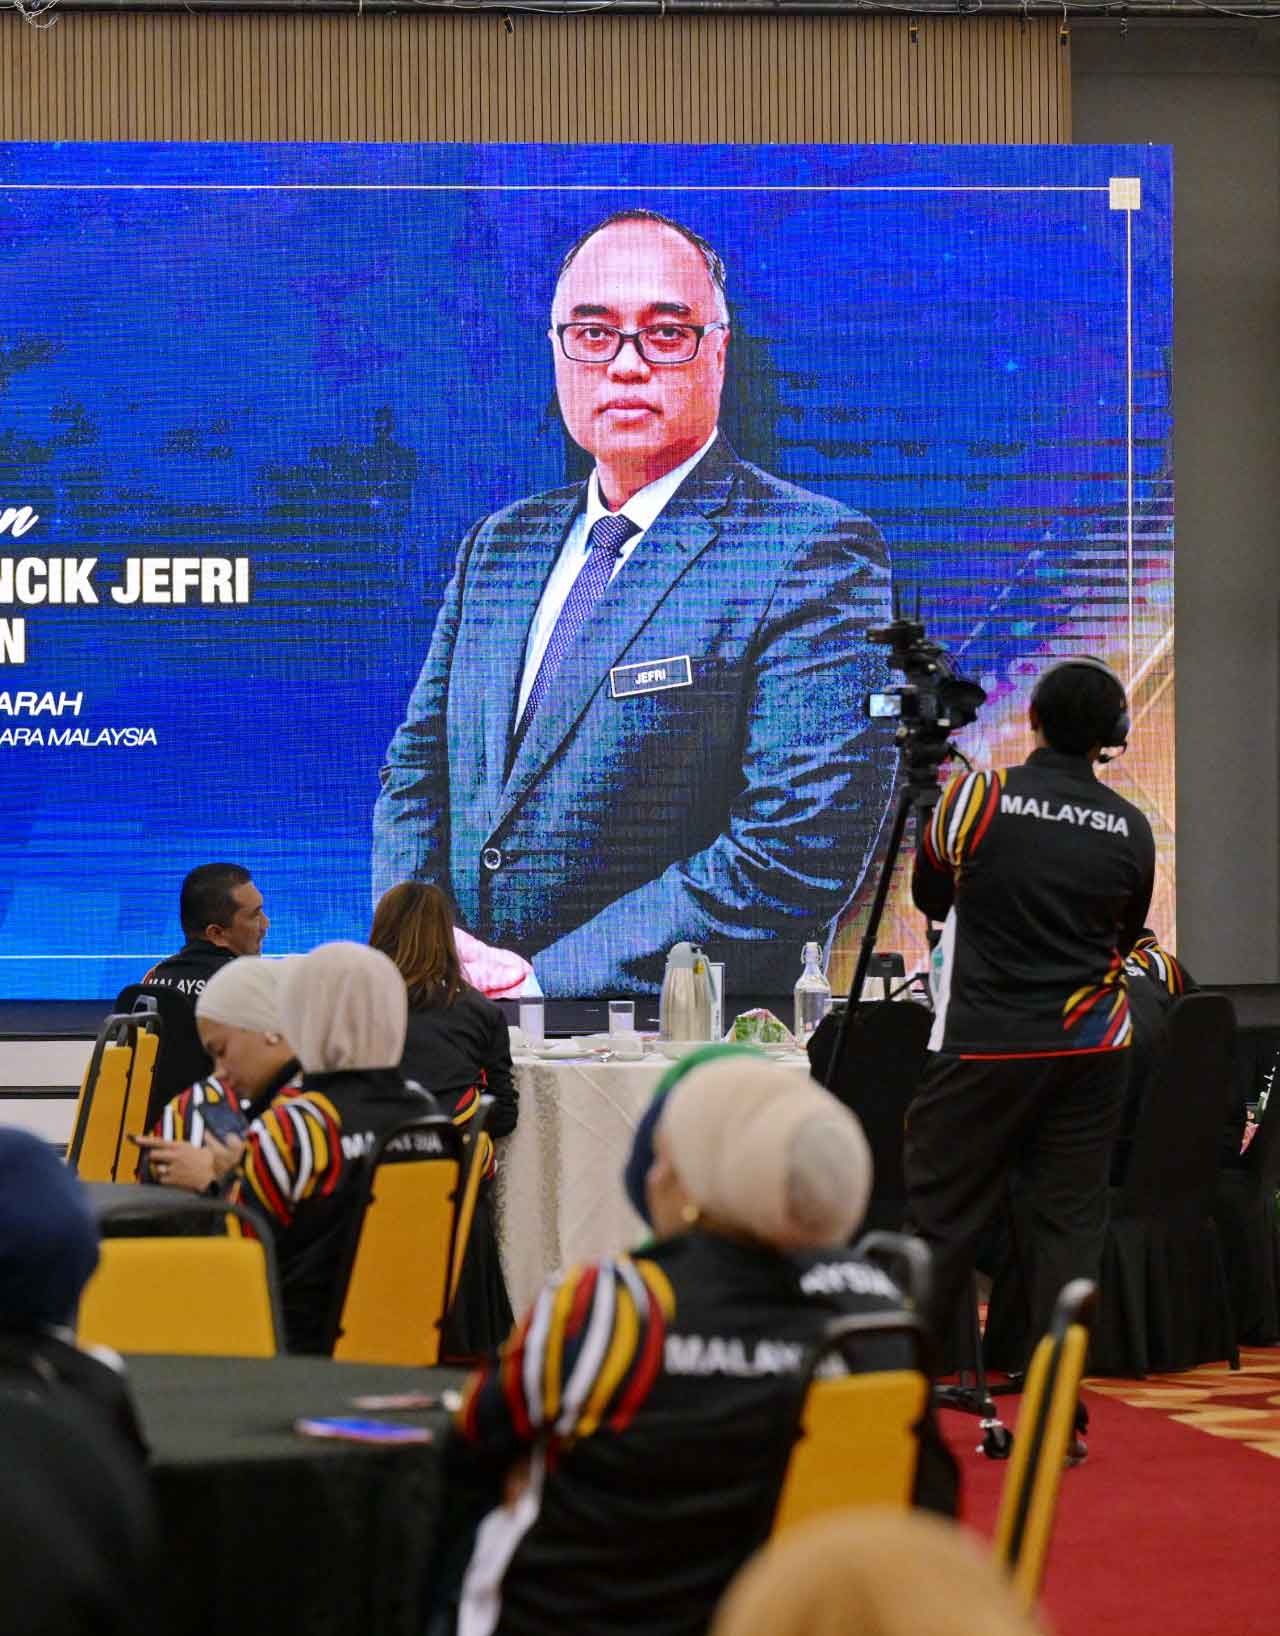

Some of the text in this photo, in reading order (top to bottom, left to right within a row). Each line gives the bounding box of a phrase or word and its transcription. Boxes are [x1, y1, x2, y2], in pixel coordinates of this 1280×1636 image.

[111, 557, 249, 604] JEFRI
[634, 668, 666, 685] JEFRI
[47, 728, 157, 747] MALAYSIA
[1000, 794, 1130, 837] MALAYSIA
